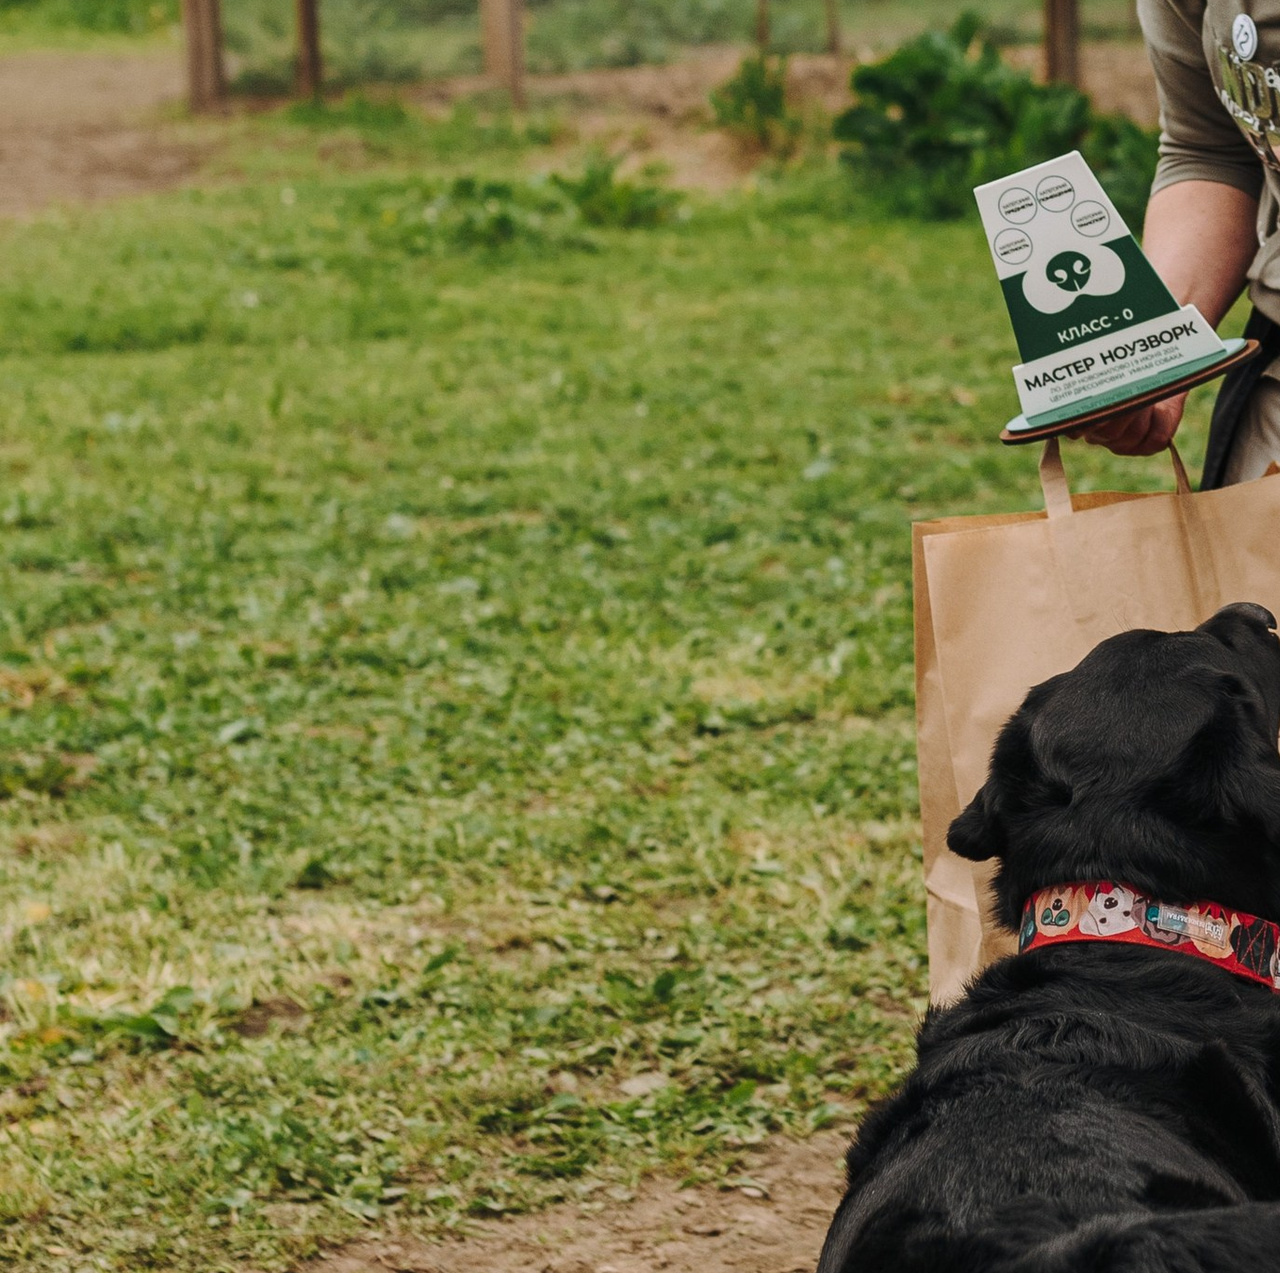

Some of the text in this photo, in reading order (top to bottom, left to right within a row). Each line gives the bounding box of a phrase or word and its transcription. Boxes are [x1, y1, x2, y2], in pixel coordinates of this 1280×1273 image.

[1057, 315, 1112, 344] КЛАСС
[1024, 321, 1199, 392] МАСТЕР НОУЗВОРК
